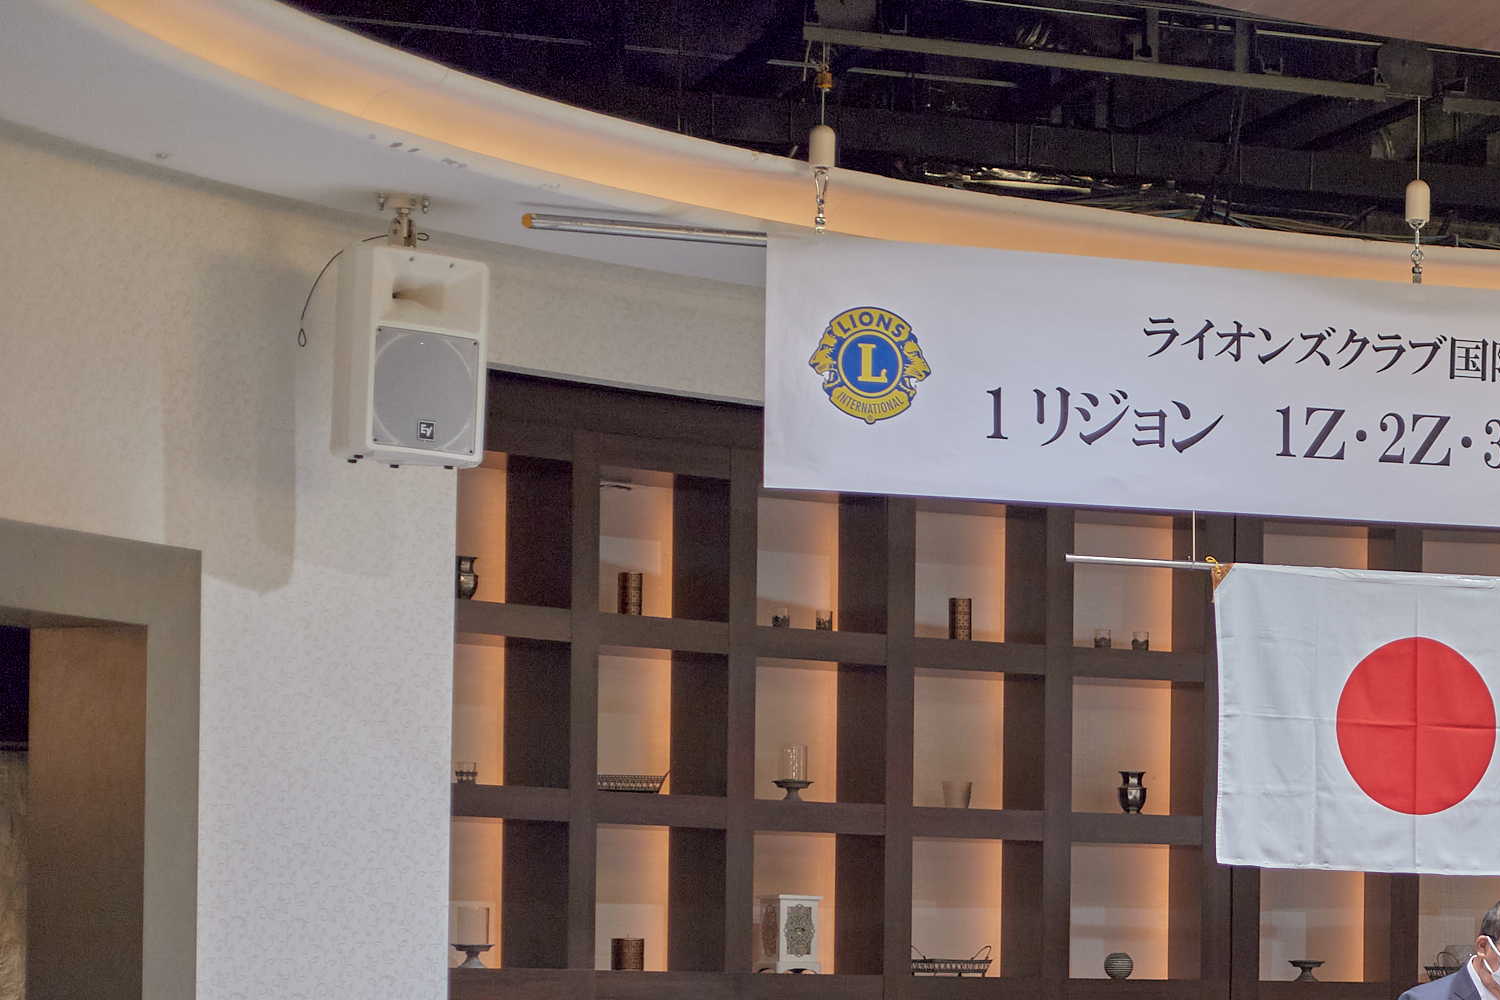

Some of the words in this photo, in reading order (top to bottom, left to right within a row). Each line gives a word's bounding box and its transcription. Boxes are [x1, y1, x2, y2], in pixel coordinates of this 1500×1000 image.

[836, 311, 905, 338] LIONS
[857, 342, 888, 383] L
[836, 391, 905, 415] INTERNATIONAL
